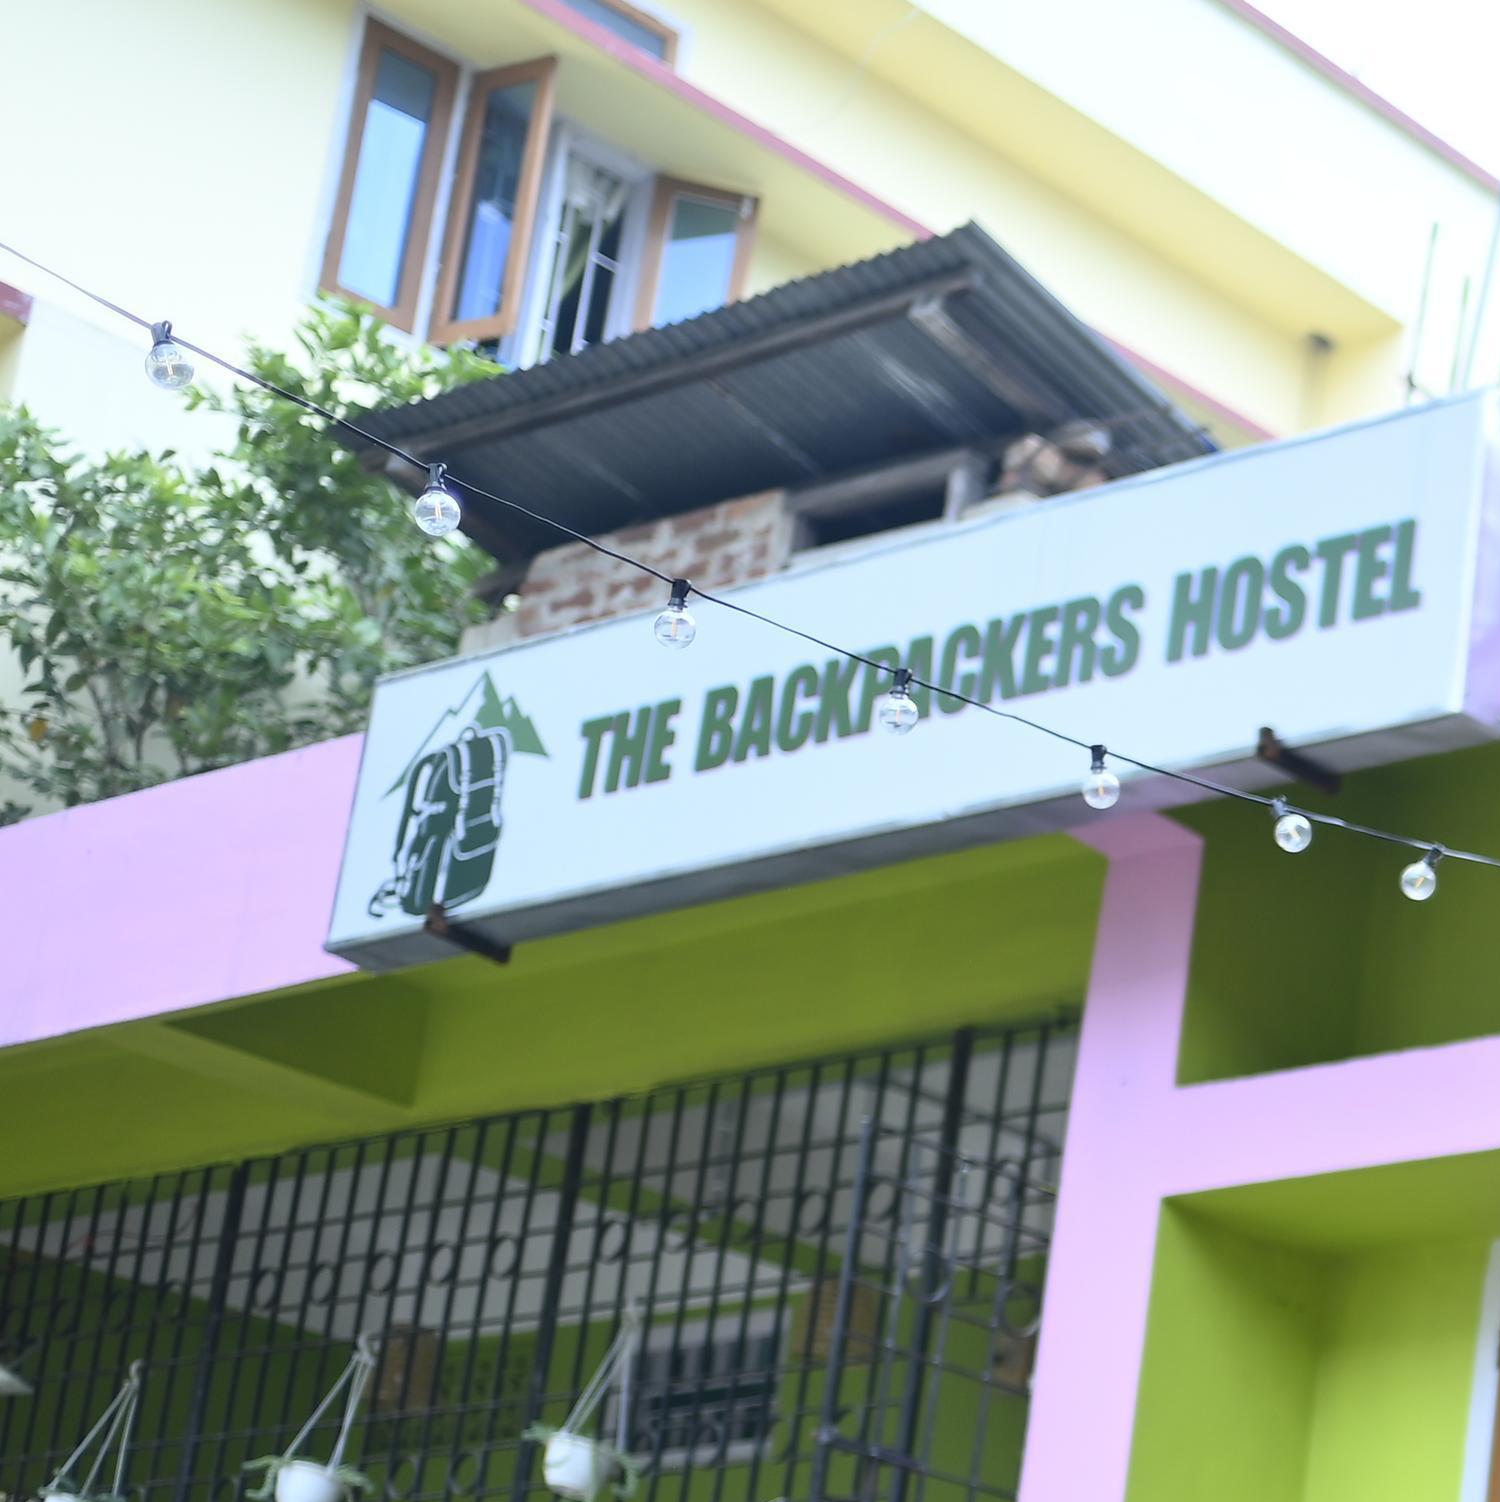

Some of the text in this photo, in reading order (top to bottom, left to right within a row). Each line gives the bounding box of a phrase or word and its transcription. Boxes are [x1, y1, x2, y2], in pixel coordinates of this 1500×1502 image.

[578, 518, 1421, 800] THE BACKPACKERS HOSTEL
